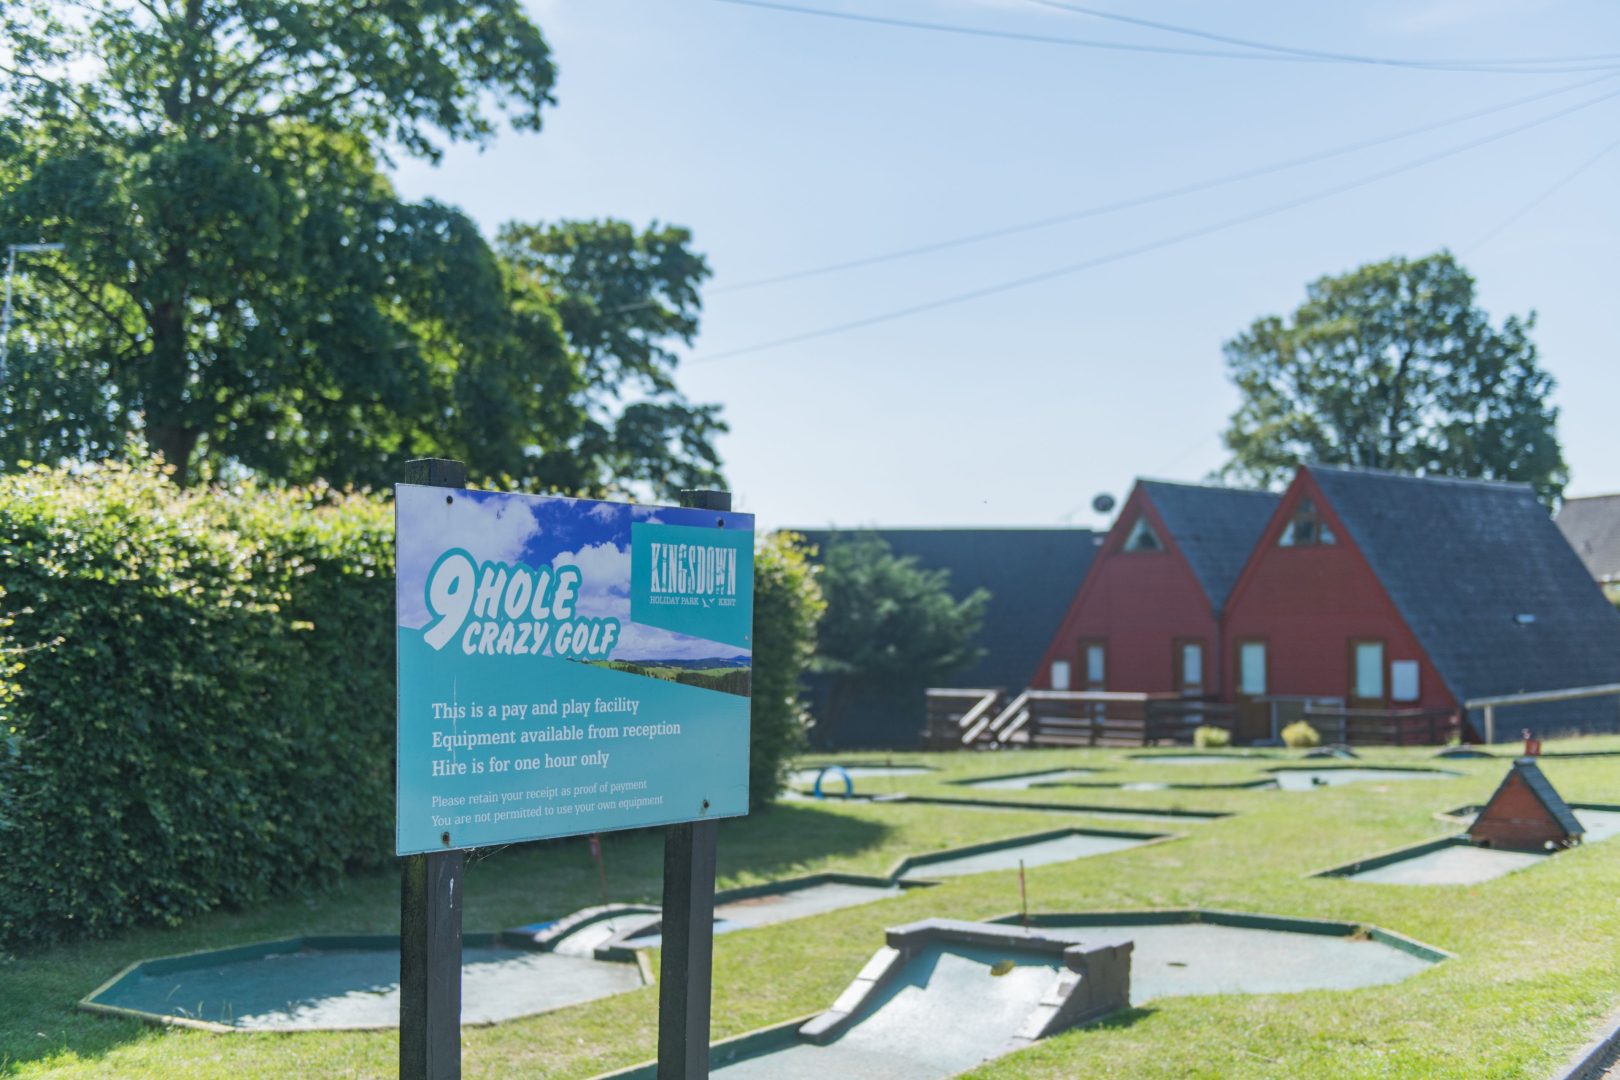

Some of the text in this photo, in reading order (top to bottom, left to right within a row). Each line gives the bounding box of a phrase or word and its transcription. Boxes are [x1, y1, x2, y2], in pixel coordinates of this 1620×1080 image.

[650, 543, 737, 595] KINGSDOWN
[424, 554, 578, 651] 9 HOLE
[649, 596, 680, 605] HOLIDAY
[681, 597, 699, 606] PARK
[462, 621, 616, 656] CRAZY GOLF
[432, 697, 640, 720] This is a pay and play facility
[432, 720, 681, 751] Equipment available from reception
[432, 750, 610, 776] Hire is for one hour only
[432, 780, 647, 808] Please retain your receipt as proof of payment
[432, 795, 664, 827] You are not permitted to use your own equipment
